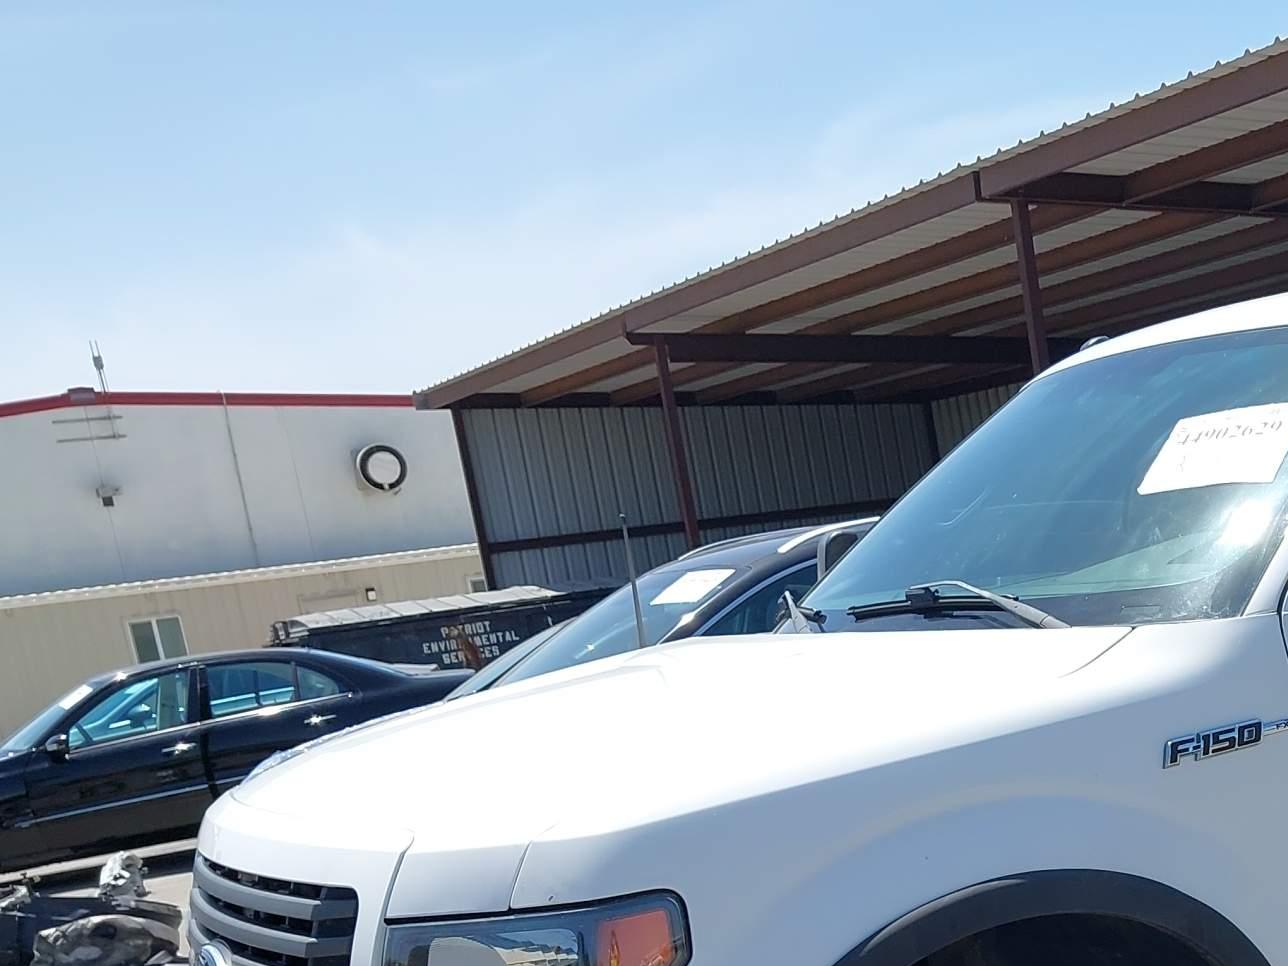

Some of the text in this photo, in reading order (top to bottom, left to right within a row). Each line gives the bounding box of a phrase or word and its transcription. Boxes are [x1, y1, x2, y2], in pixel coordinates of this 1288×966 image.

[440, 621, 490, 638] PATRIOT
[422, 630, 520, 655] ENVIRMENTAL
[441, 645, 500, 665] SERCES
[1163, 719, 1263, 769] F-150
